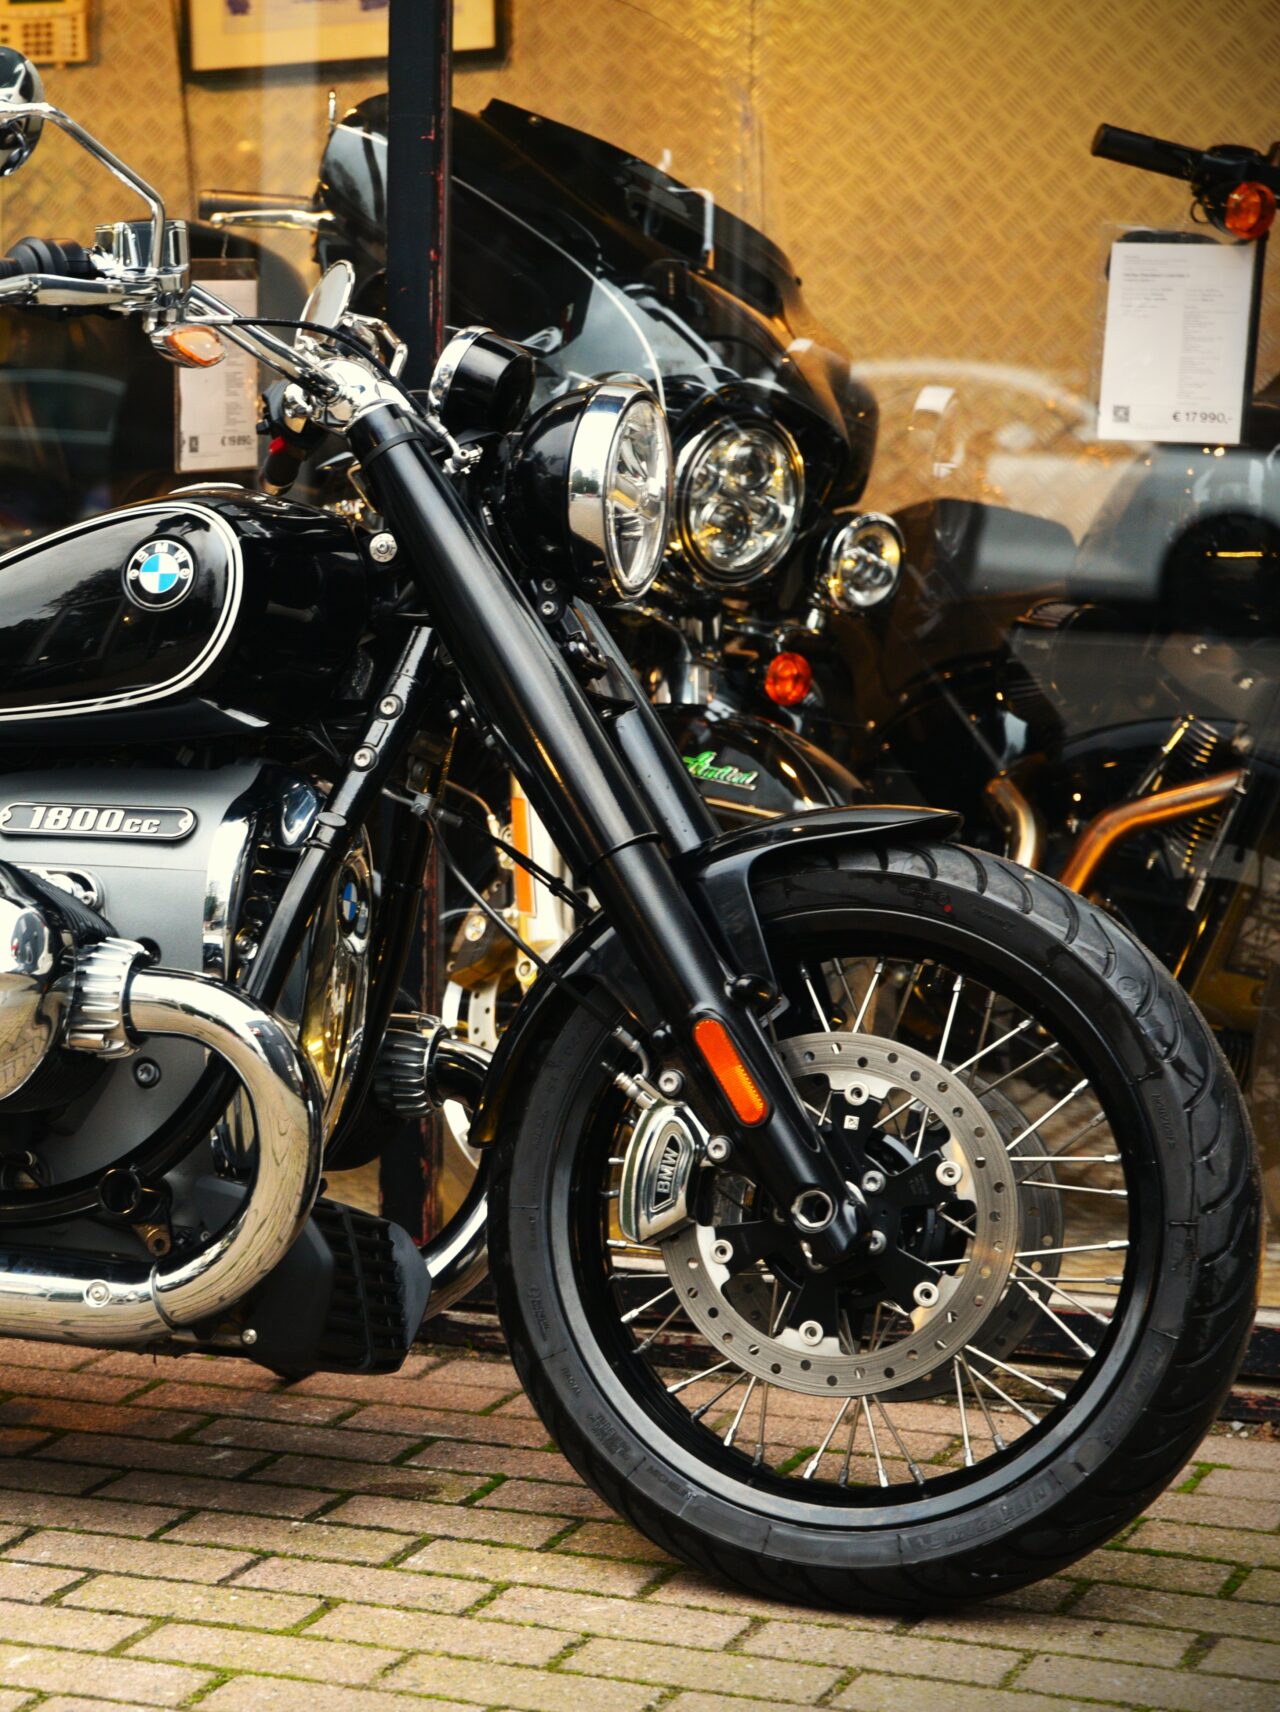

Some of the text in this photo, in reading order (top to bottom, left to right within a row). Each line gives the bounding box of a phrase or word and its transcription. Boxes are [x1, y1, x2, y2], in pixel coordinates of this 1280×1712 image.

[134, 541, 189, 564] BMW
[29, 806, 161, 833] 1800cc
[656, 1146, 680, 1194] BMW
